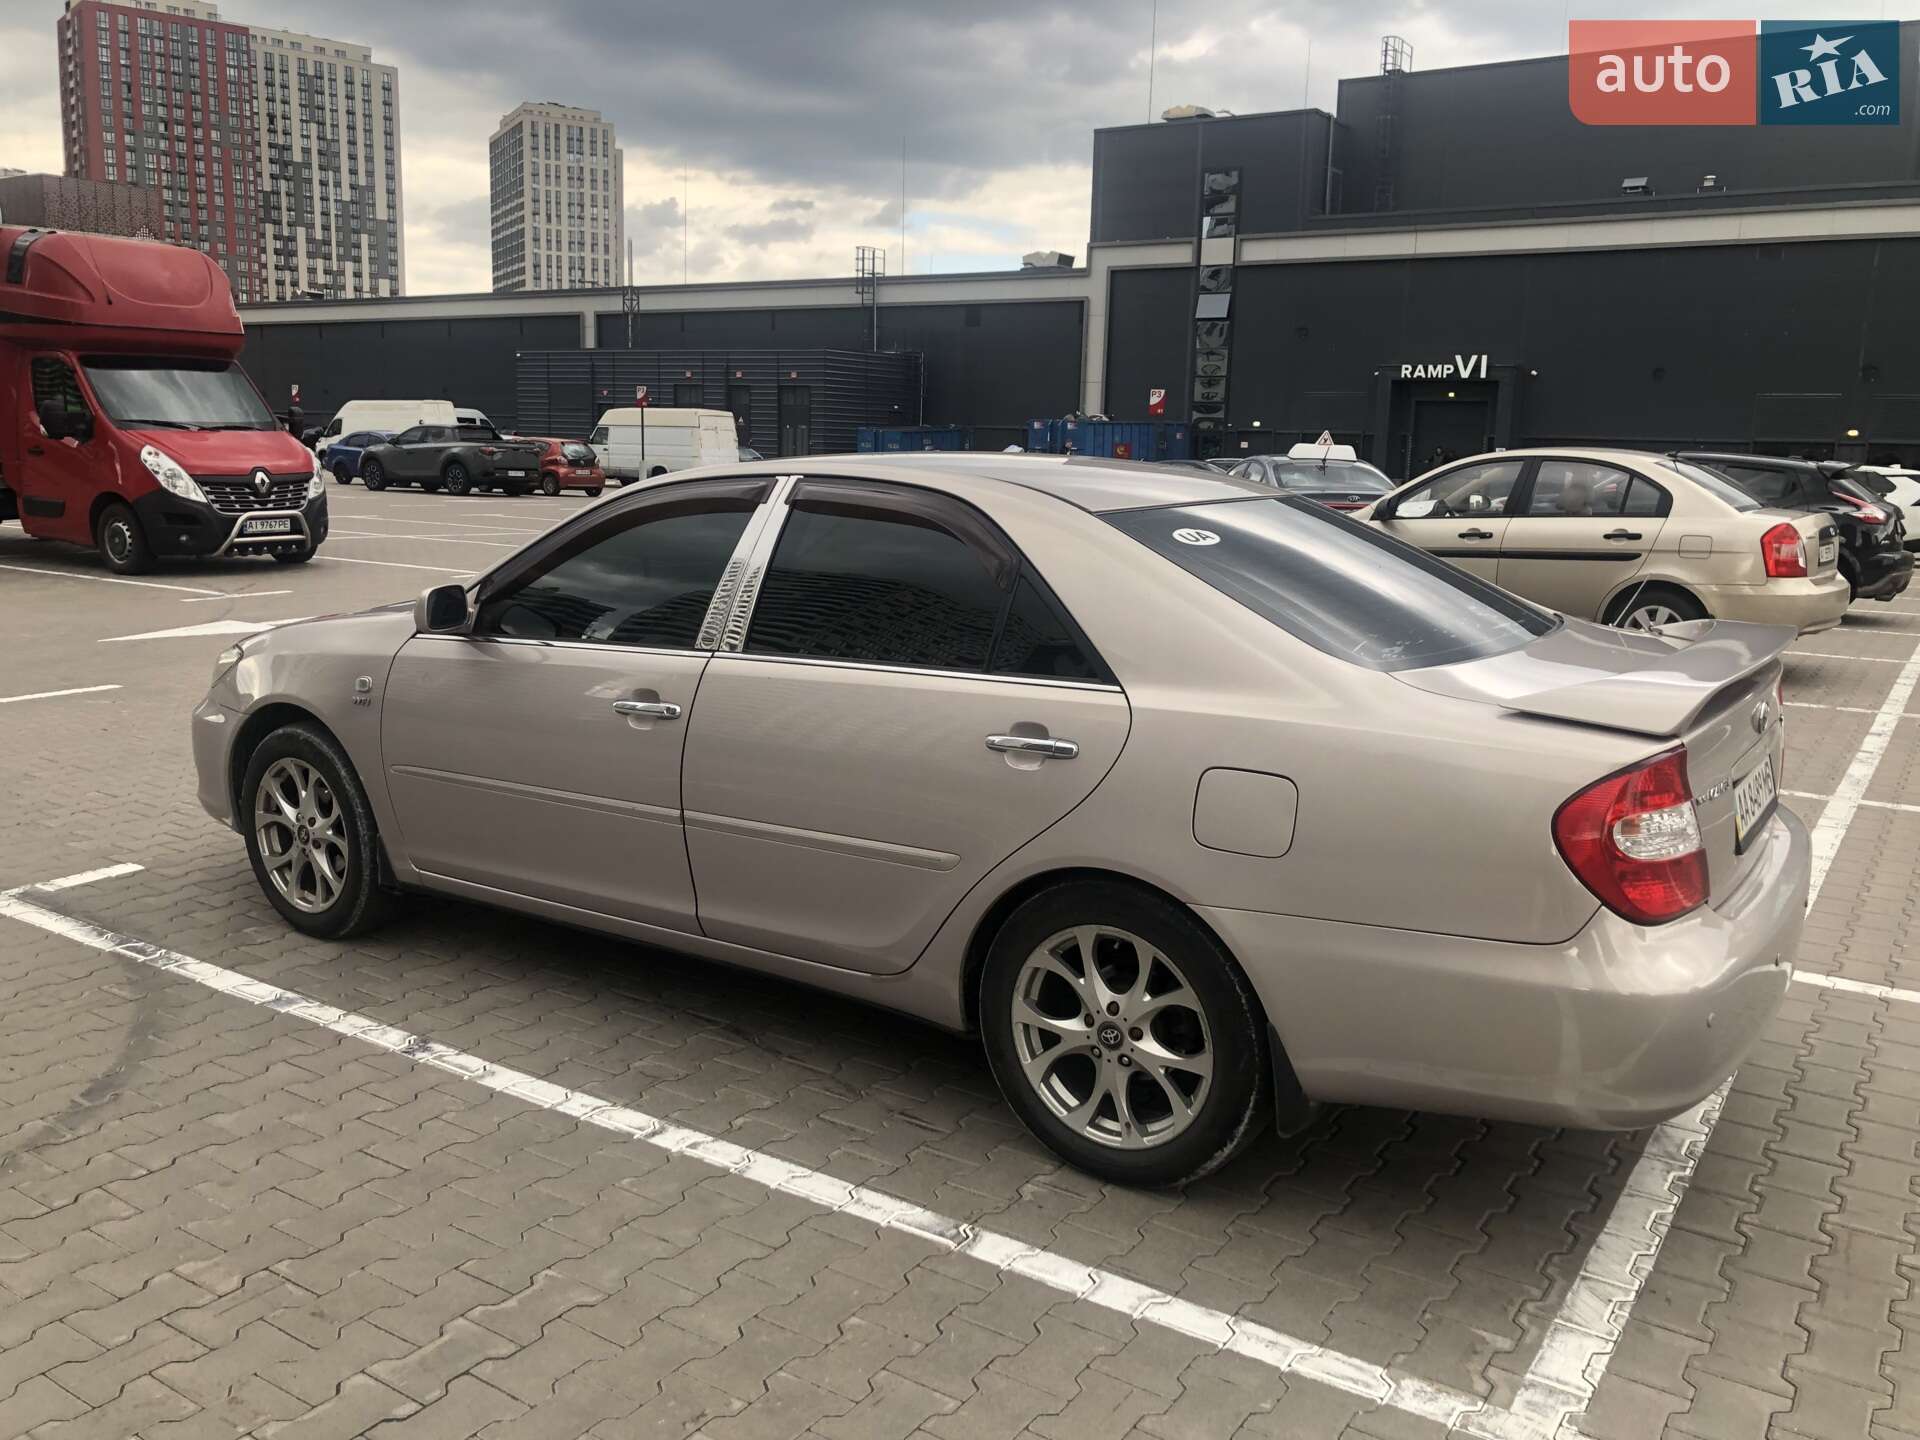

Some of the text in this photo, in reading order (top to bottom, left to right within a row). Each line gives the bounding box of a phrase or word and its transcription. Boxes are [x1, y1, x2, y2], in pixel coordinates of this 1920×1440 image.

[1401, 354, 1488, 379] RAMP VI
[1151, 390, 1162, 398] P3
[1177, 531, 1216, 542] UA
